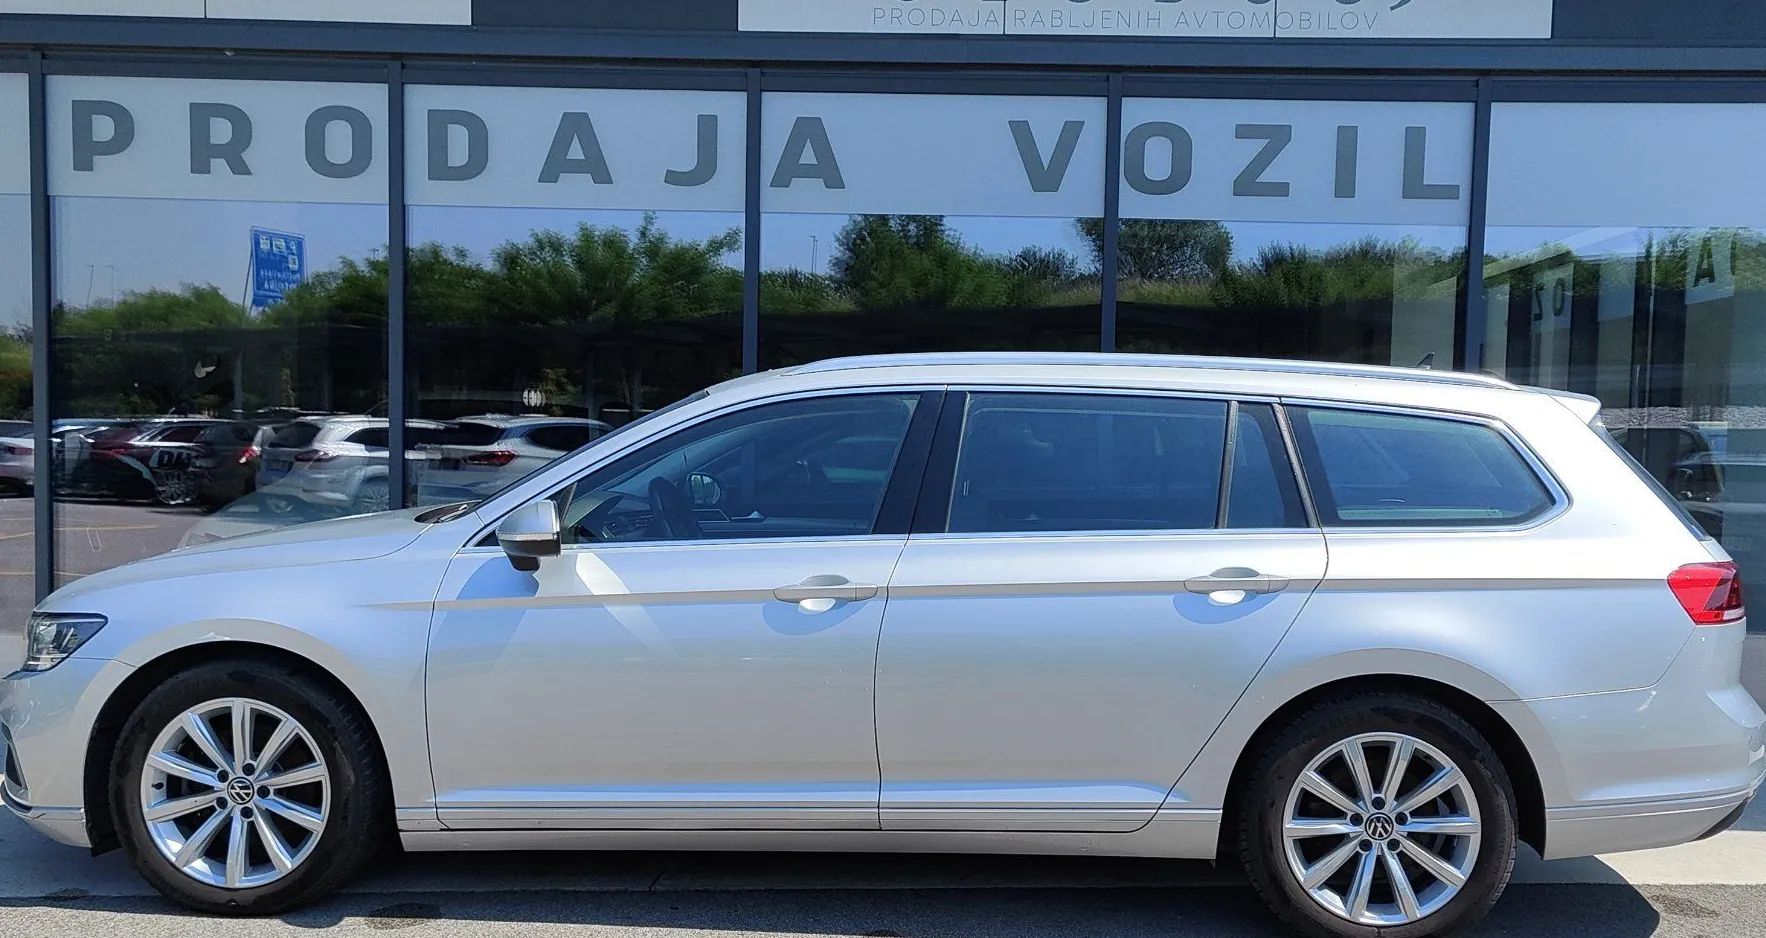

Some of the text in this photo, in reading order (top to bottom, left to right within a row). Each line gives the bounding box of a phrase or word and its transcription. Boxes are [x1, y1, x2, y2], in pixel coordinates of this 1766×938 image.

[873, 7, 1379, 30] PRODAJA RABLJENIH AVTOMOBILOV
[71, 99, 1461, 200] PRODAJA VOZIL
